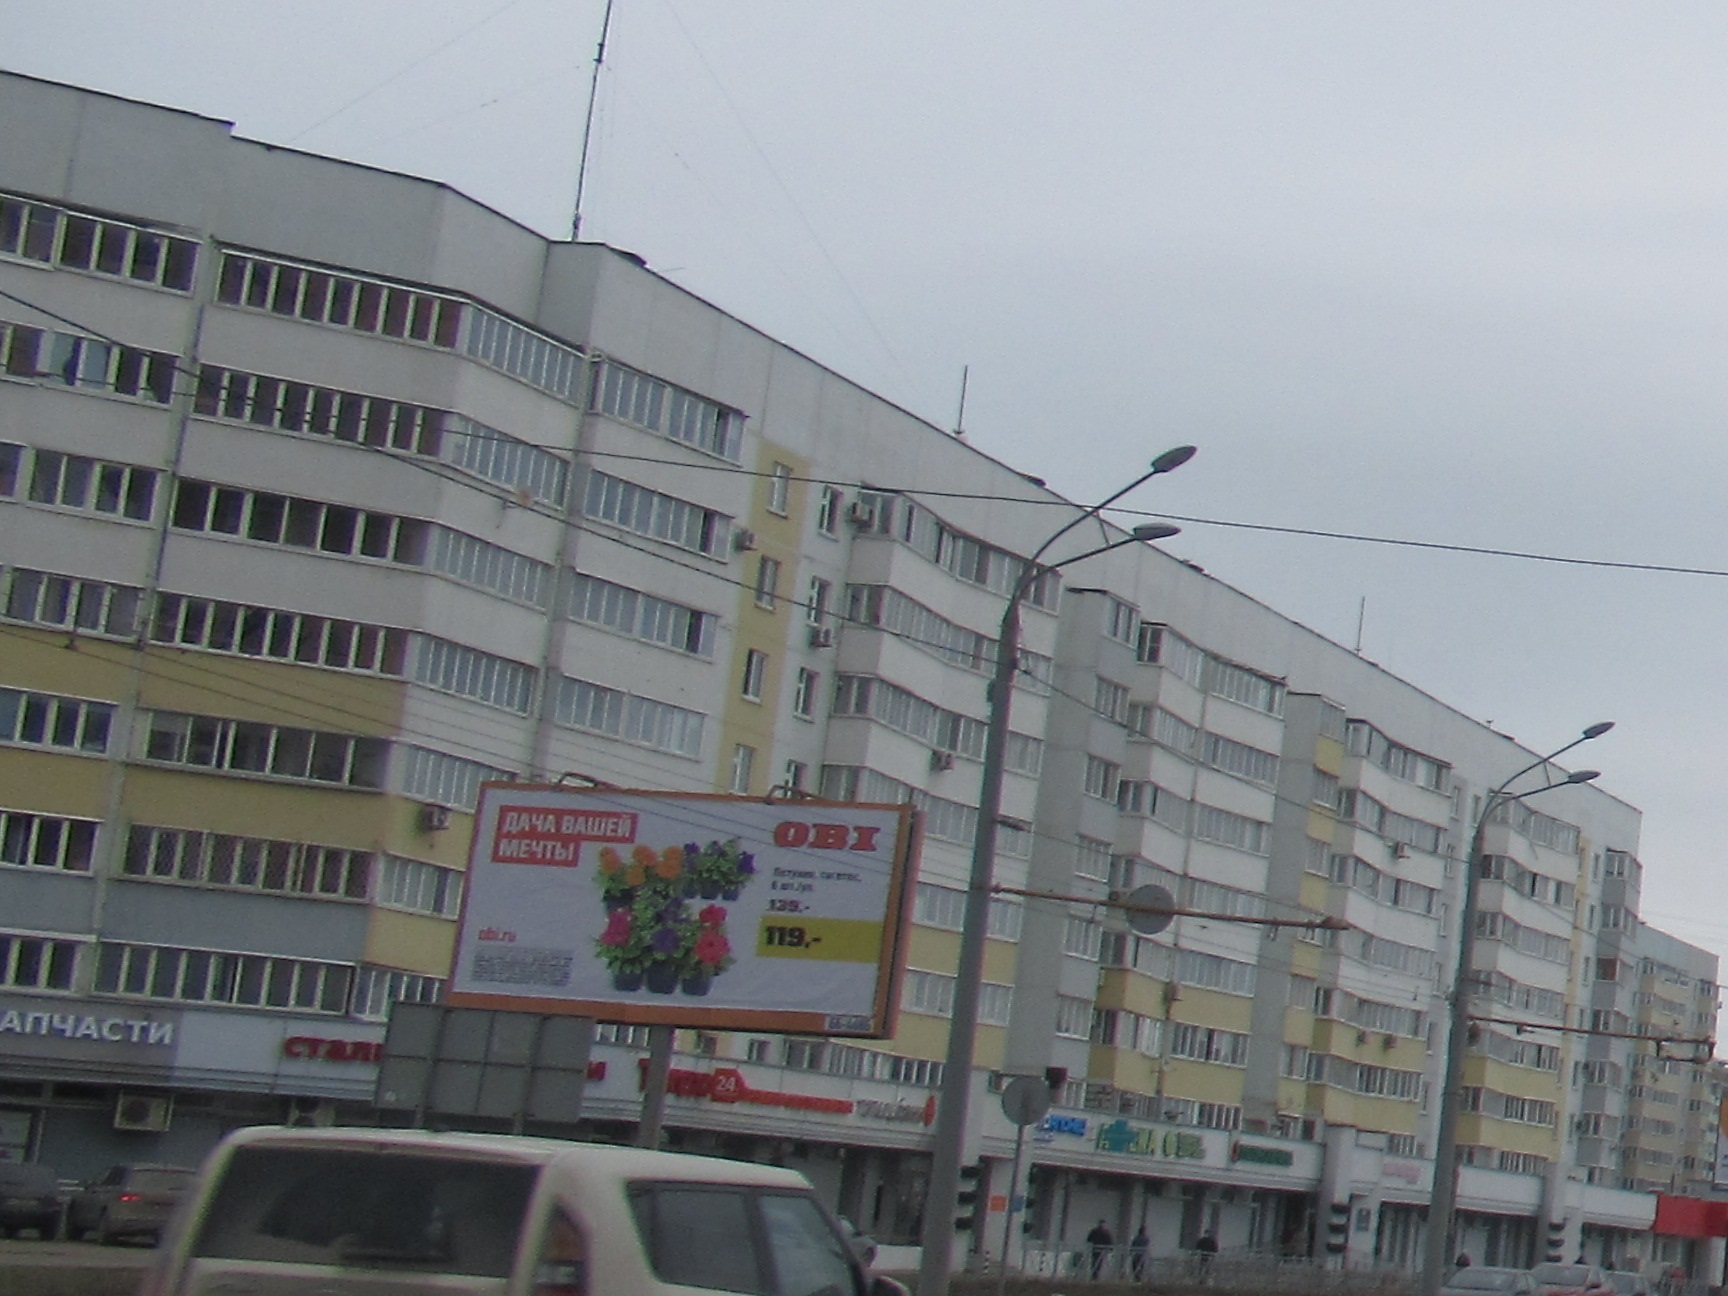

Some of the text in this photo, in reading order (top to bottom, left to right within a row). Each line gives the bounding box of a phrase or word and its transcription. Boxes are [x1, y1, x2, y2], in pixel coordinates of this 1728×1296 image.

[505, 811, 632, 838] ДАЧА ВАШЕЙ
[774, 821, 882, 852] OBI
[499, 838, 575, 861] МЕЧТЫ
[717, 1075, 736, 1092] 24
